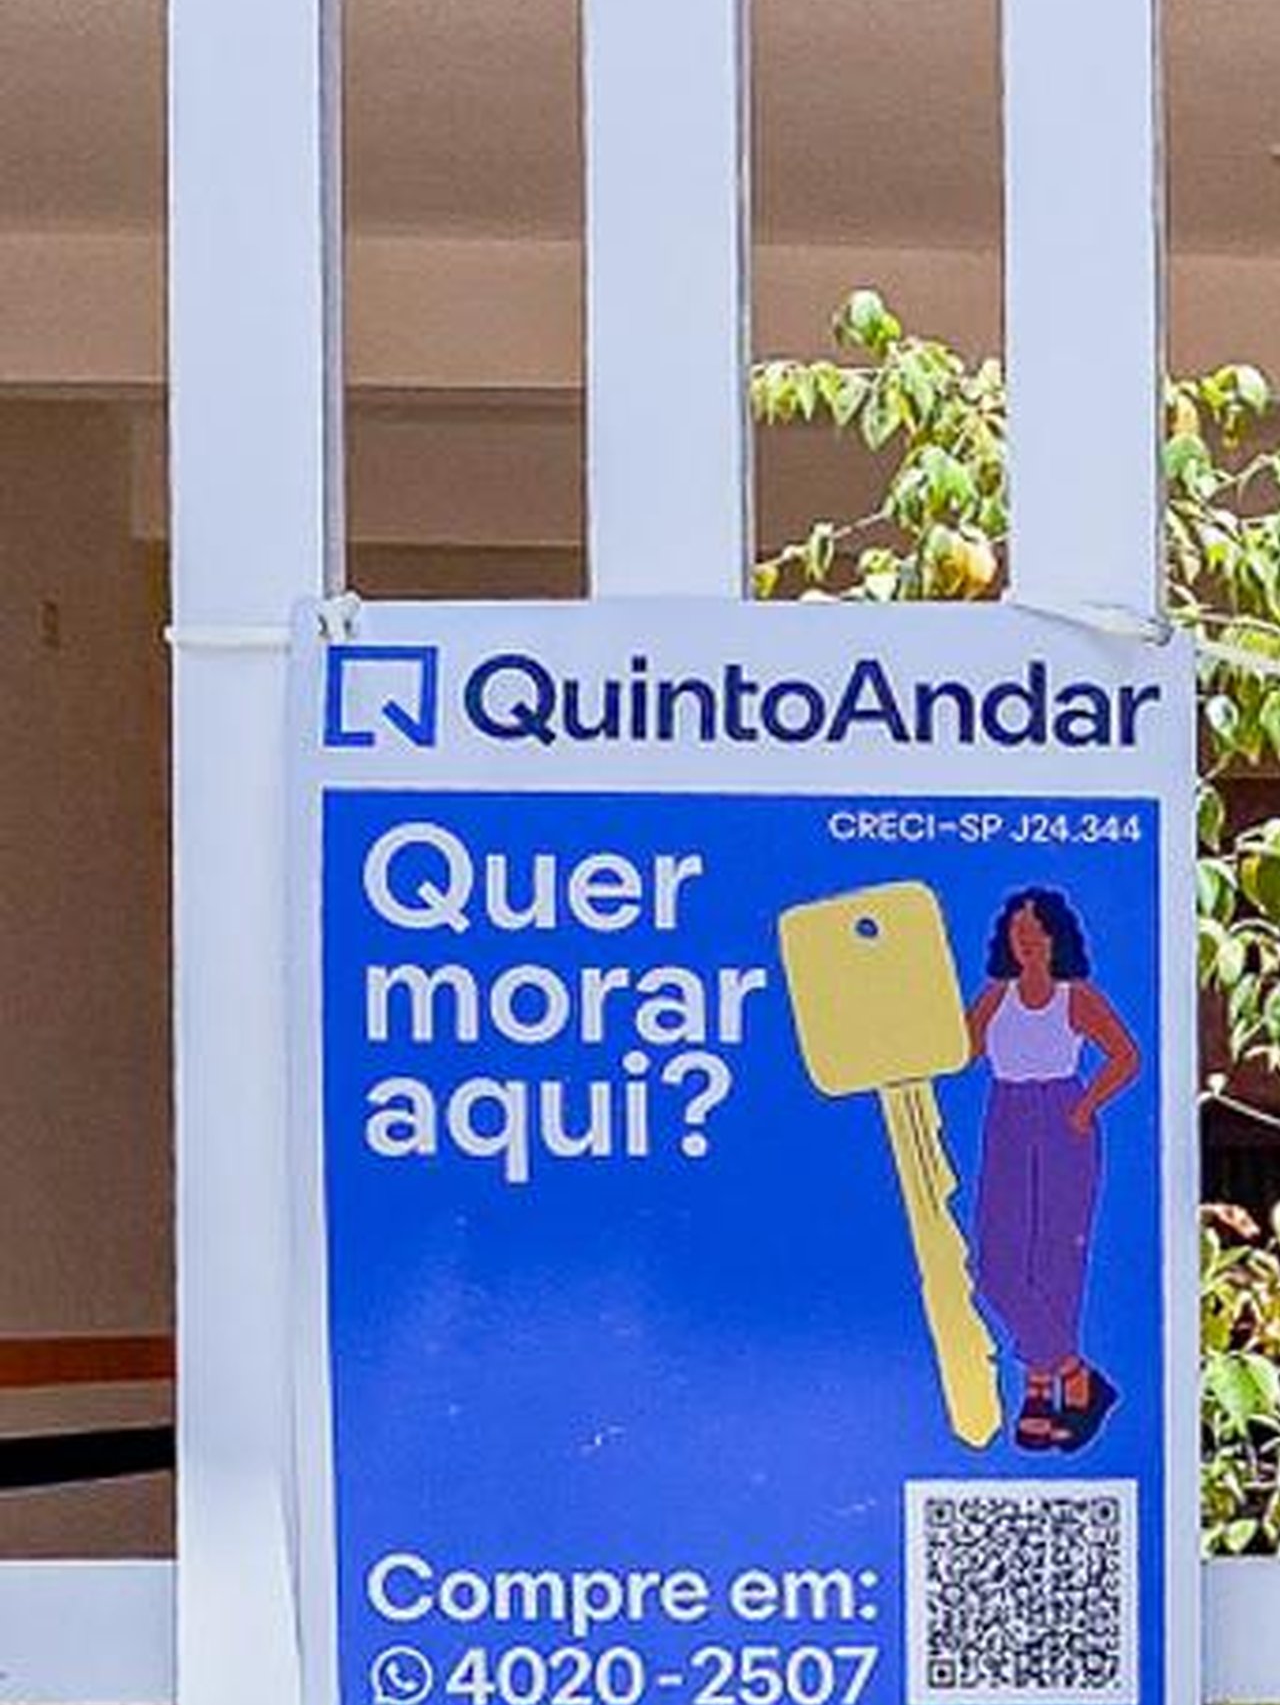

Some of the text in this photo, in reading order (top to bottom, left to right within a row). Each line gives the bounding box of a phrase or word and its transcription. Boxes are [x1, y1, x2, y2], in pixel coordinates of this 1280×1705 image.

[464, 653, 1162, 748] QuintoAndar
[828, 812, 1142, 844] CRECI-SP J24.344
[362, 821, 702, 934] Quer
[364, 962, 768, 1045] morar
[364, 1051, 733, 1183] aqui?
[366, 1552, 880, 1639] Compre em:
